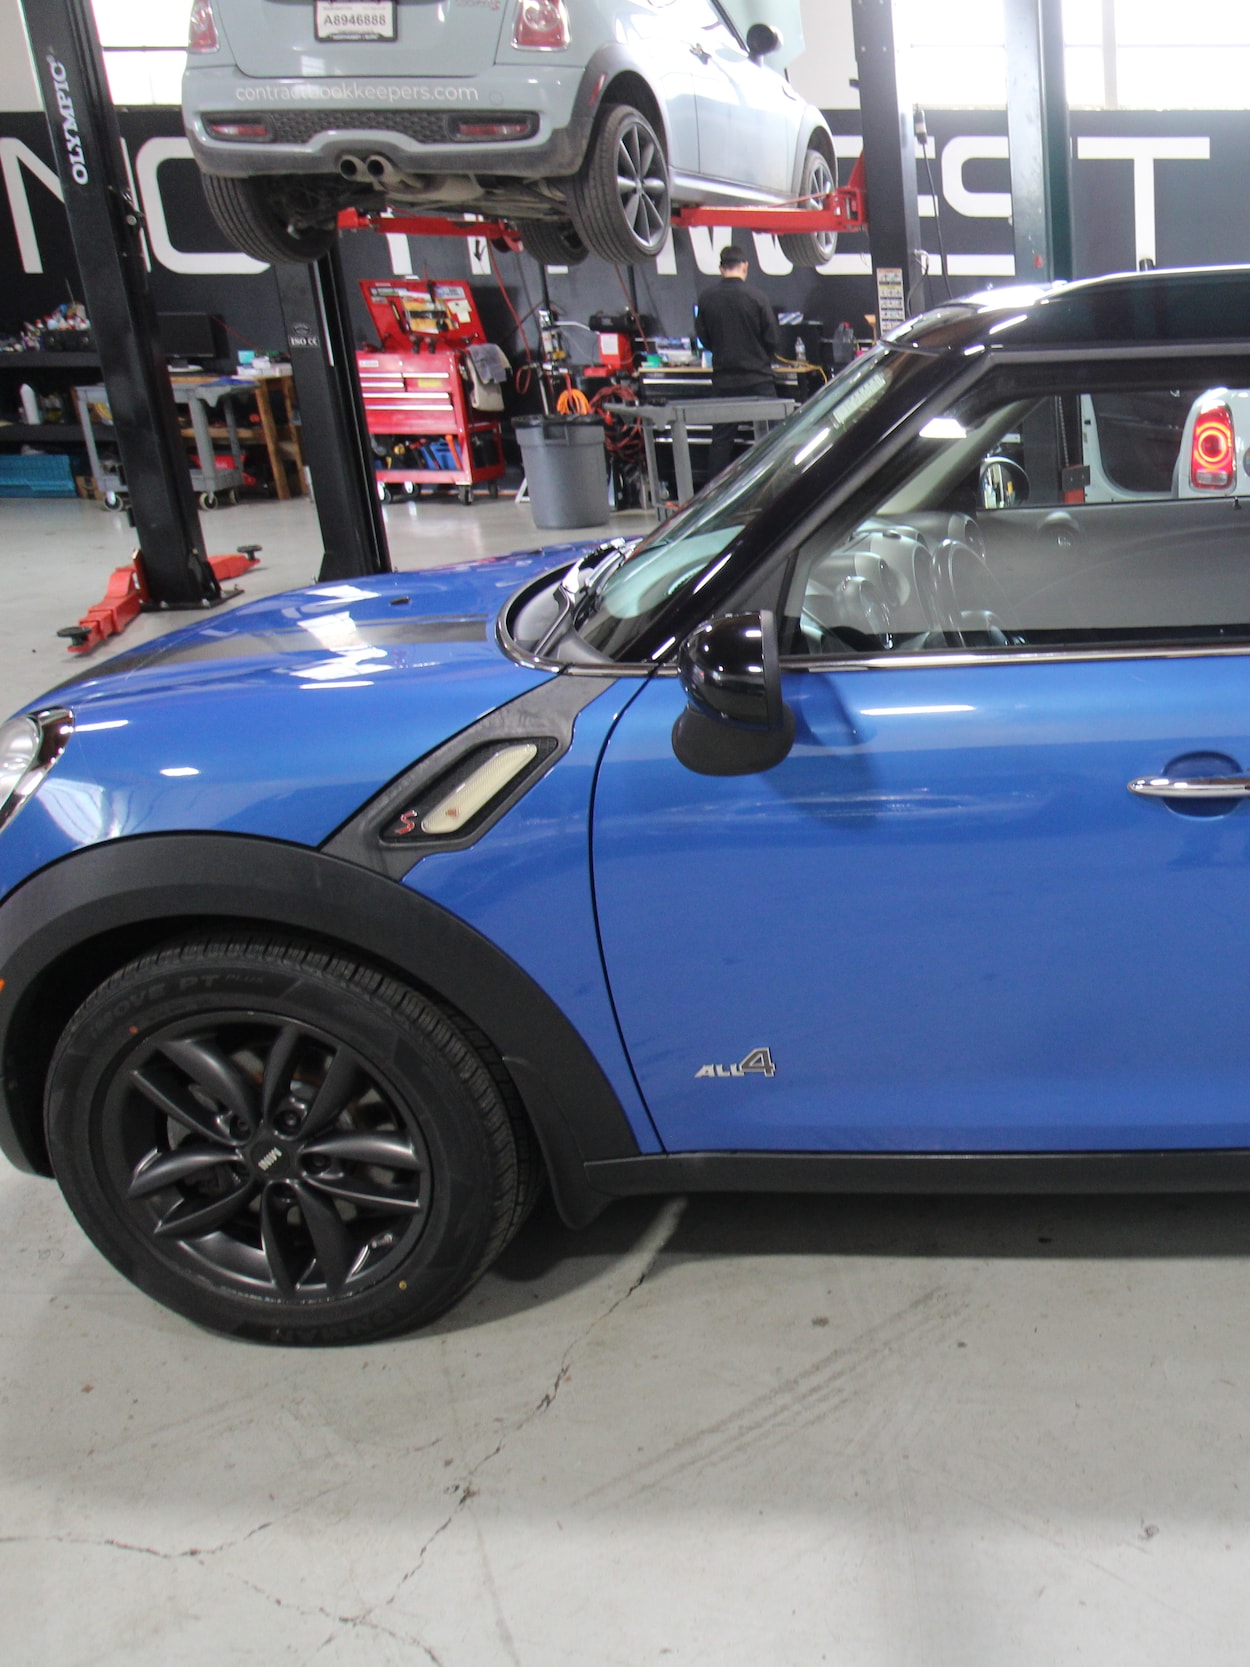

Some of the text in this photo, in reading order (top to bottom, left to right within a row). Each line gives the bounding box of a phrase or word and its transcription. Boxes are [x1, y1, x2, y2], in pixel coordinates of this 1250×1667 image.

[322, 14, 387, 26] A8946888
[235, 81, 479, 102] contractbookkeepers.com
[394, 809, 418, 836] S
[694, 1047, 775, 1079] ALL4
